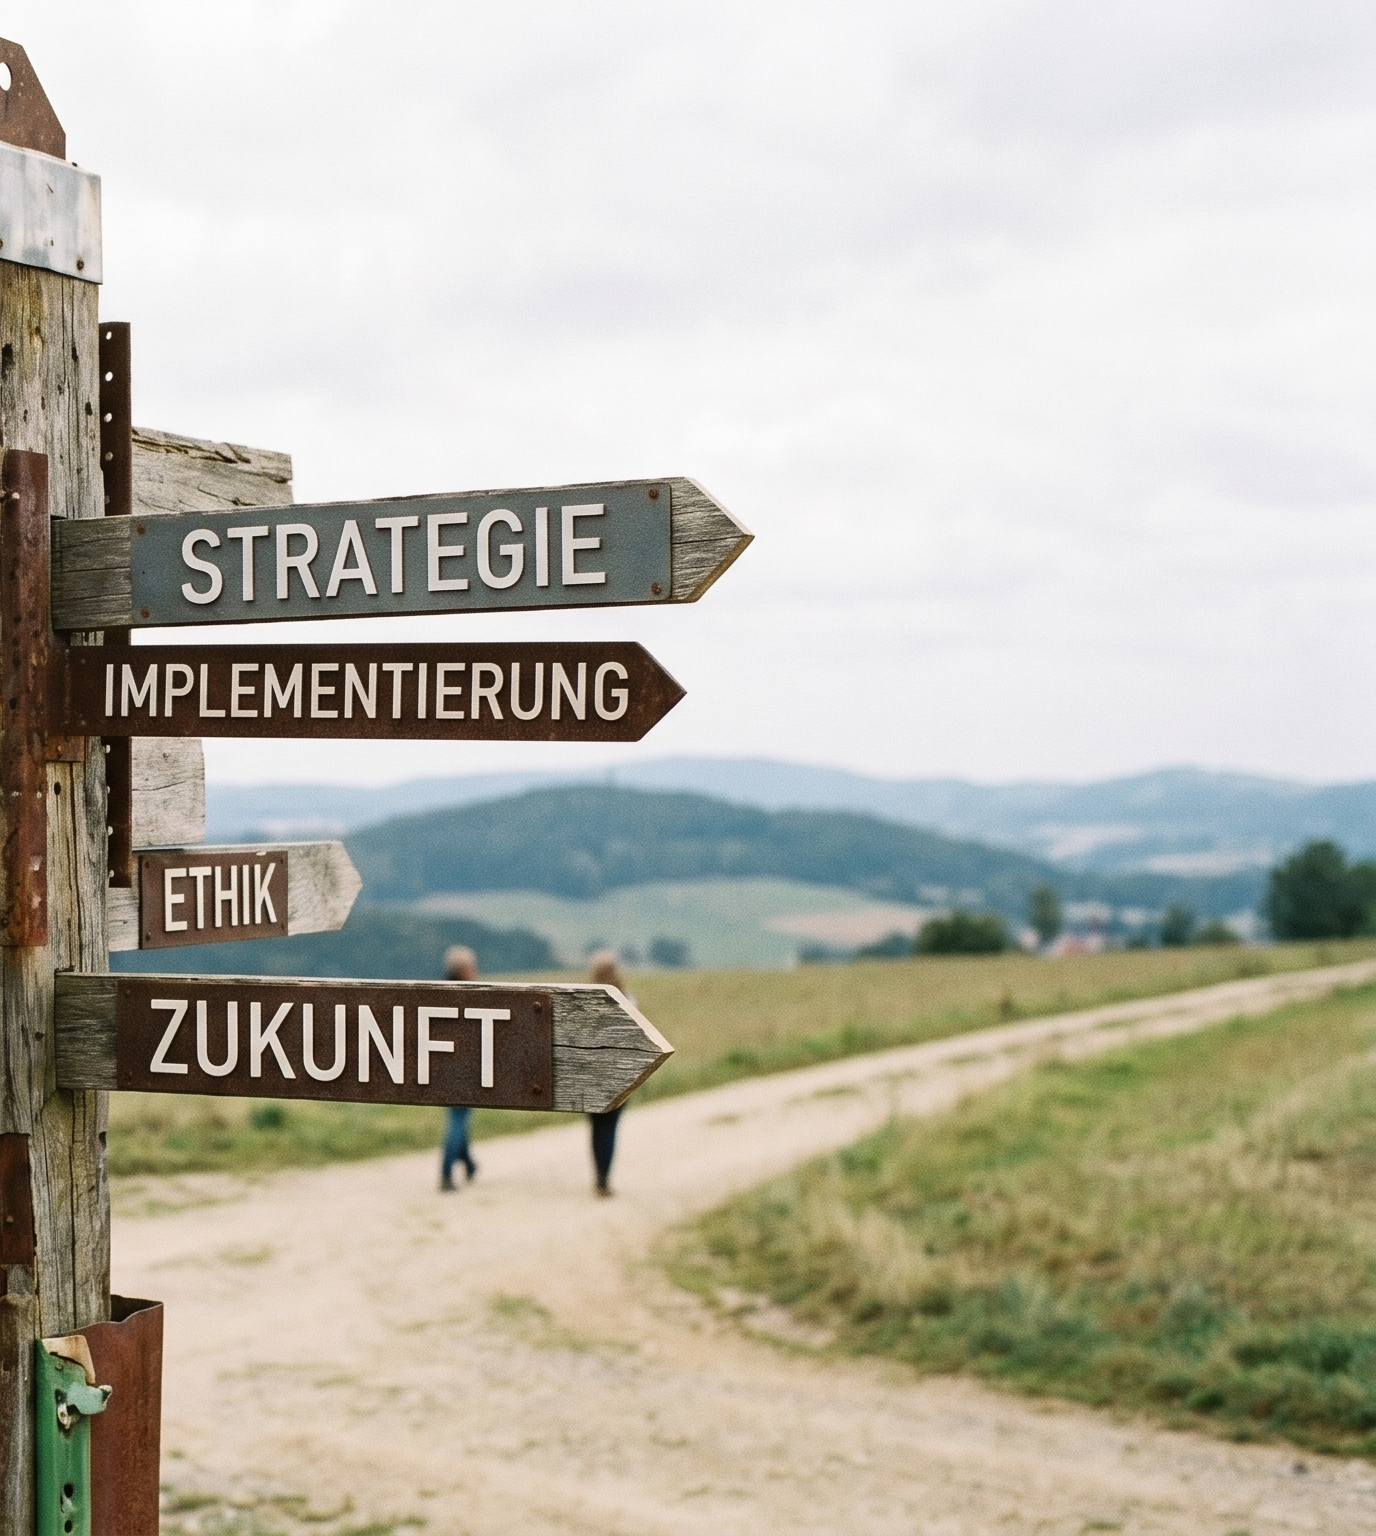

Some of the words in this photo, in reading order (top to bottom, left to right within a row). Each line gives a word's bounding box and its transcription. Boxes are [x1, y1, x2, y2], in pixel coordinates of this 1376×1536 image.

[180, 503, 607, 605] STRATEGIE
[104, 661, 630, 722] IMPLEMENTIERUNG
[163, 862, 279, 932] ETHIK
[149, 998, 512, 1089] ZUKUNFT
